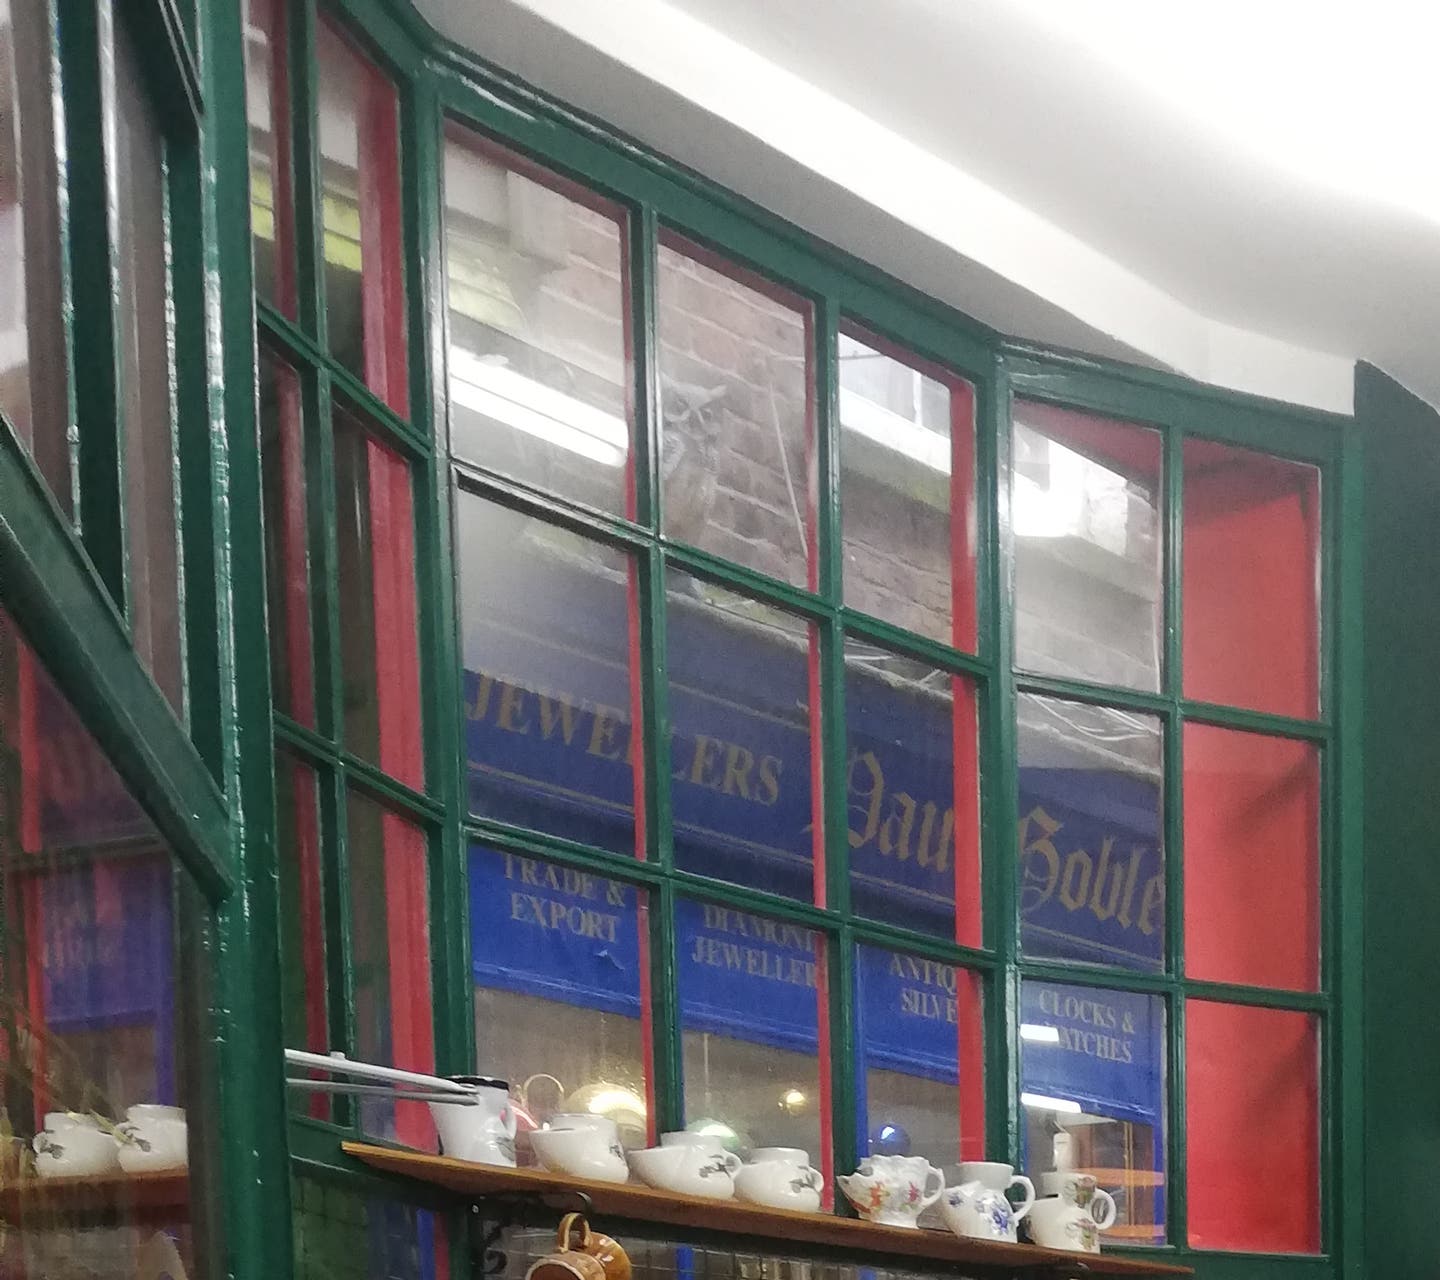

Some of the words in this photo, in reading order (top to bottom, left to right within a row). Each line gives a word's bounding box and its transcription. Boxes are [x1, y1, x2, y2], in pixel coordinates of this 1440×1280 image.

[511, 892, 622, 943] EXPORT
[901, 987, 958, 1024] SILVE
[1038, 989, 1117, 1032] CLOCKS
[1043, 1022, 1134, 1064] ATCHES
